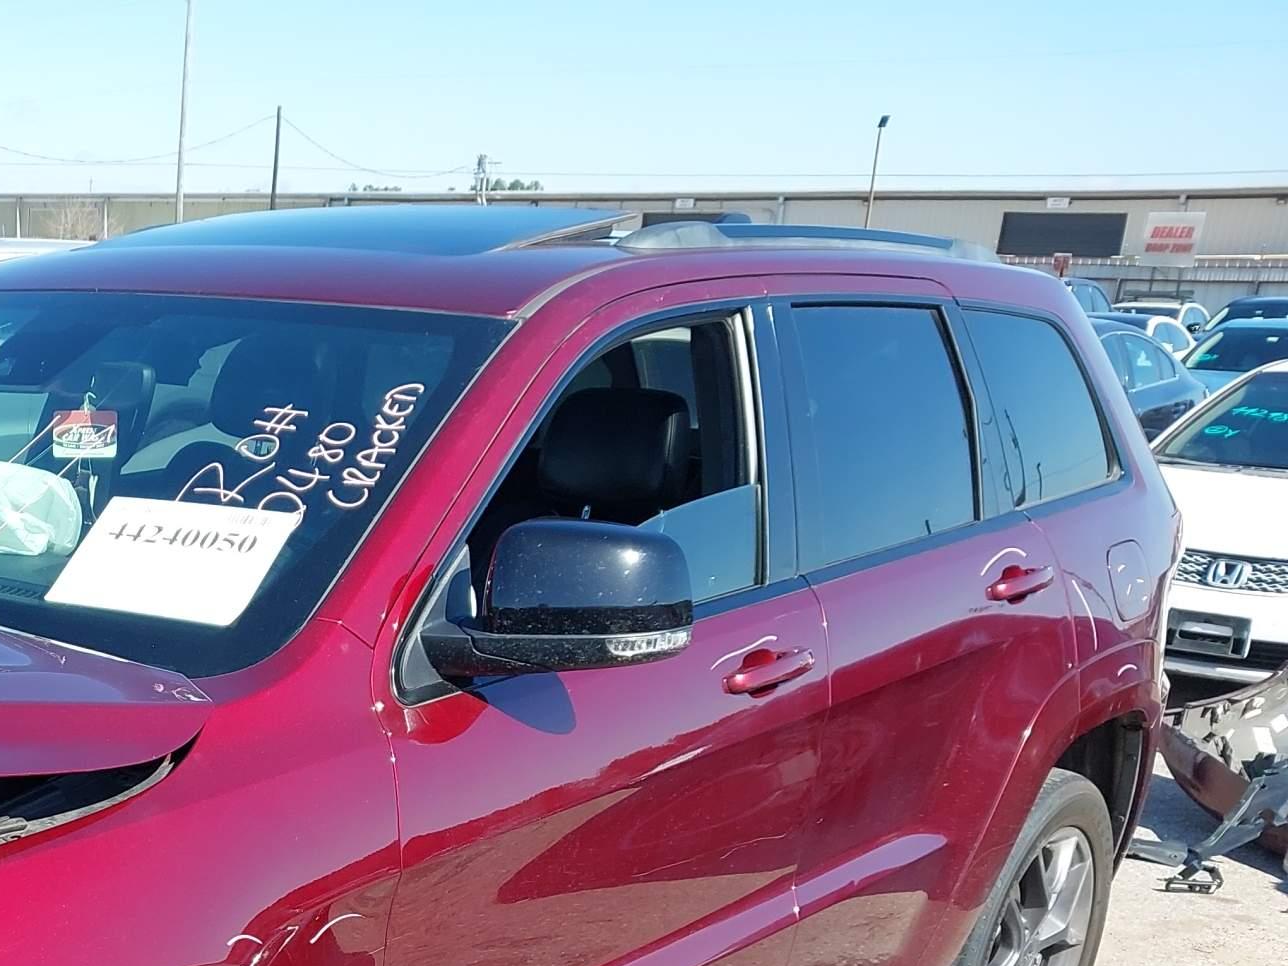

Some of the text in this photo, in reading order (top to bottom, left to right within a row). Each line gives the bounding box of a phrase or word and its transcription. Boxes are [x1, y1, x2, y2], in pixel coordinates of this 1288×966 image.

[1150, 226, 1195, 239] DEALER
[327, 382, 425, 508] CRACKED
[108, 521, 258, 554] 44240050
